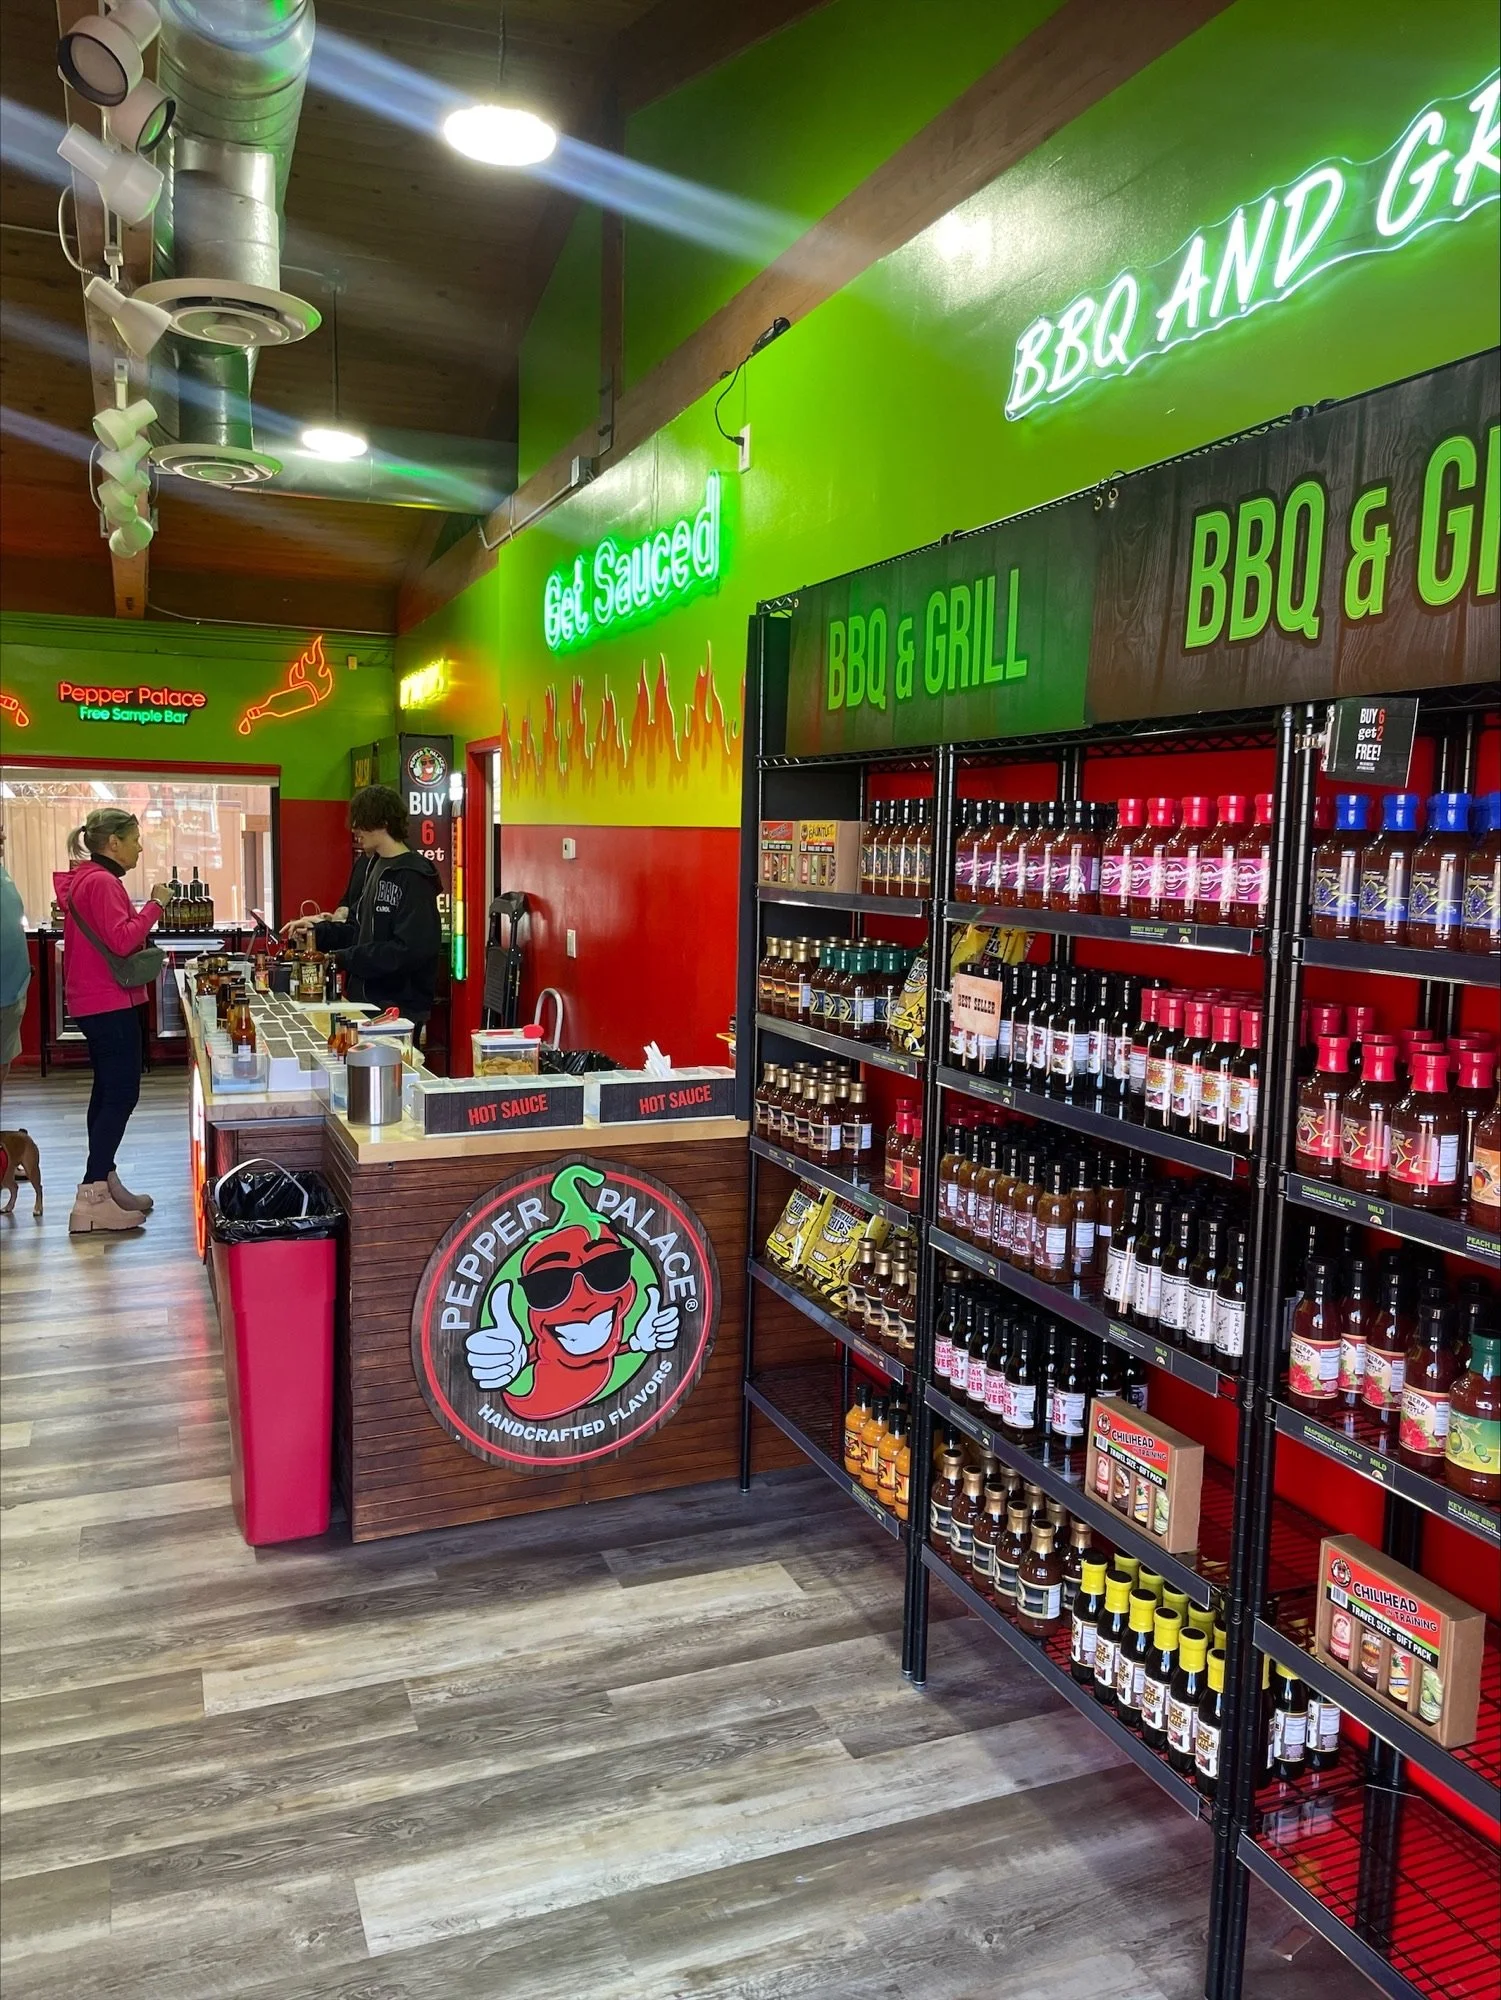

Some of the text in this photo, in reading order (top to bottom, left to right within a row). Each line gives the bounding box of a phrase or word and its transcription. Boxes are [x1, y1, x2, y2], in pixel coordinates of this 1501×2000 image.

[1007, 271, 1139, 416] BBQ
[1155, 166, 1344, 341] AND
[544, 469, 721, 650] Get Sauced
[1184, 480, 1327, 649] BBQ
[1345, 486, 1391, 620] &
[827, 567, 1028, 711] BBQ & GRILL
[60, 682, 206, 707] Pepper Palace
[79, 705, 189, 725] Free Sample Bar
[1359, 707, 1386, 725] BUY 6
[1357, 725, 1384, 742] get 2
[1355, 743, 1381, 761] FREE!
[409, 791, 446, 816] BUY
[421, 820, 435, 845] 6
[957, 994, 996, 1015] BEST SELLER
[467, 1094, 548, 1126] HOT SAUCE
[639, 1084, 713, 1116] HOT SAUCE
[1301, 1184, 1332, 1200] CINNAMON
[1337, 1195, 1357, 1208] APPLE
[1367, 1203, 1385, 1216] MILD
[1466, 1235, 1491, 1249] PEACH
[440, 1187, 698, 1331] PEPPER PALACE
[477, 1358, 674, 1443] HANDCRAFTED FLAVORS
[1111, 1428, 1155, 1449] CHILIHEAD
[1140, 1447, 1167, 1461] TRAINING
[1303, 1425, 1335, 1445] RASPBERRY
[1335, 1440, 1363, 1461] CHIPOTLE
[1369, 1457, 1387, 1472] MILD
[1109, 1448, 1126, 1465] TRAVEL
[1126, 1457, 1136, 1470] SIZE
[1139, 1464, 1151, 1477] GIFT
[1150, 1470, 1163, 1486] PACK
[1448, 1499, 1497, 1531] KEY LIME BBQ
[1352, 1581, 1418, 1614] CHILIHEAD
[1350, 1603, 1376, 1627] TRAVEL
[1376, 1619, 1391, 1637] SIZE
[1396, 1631, 1414, 1650] GIFT
[1413, 1643, 1432, 1663] PACK
[1394, 1611, 1438, 1632] TRAINING
